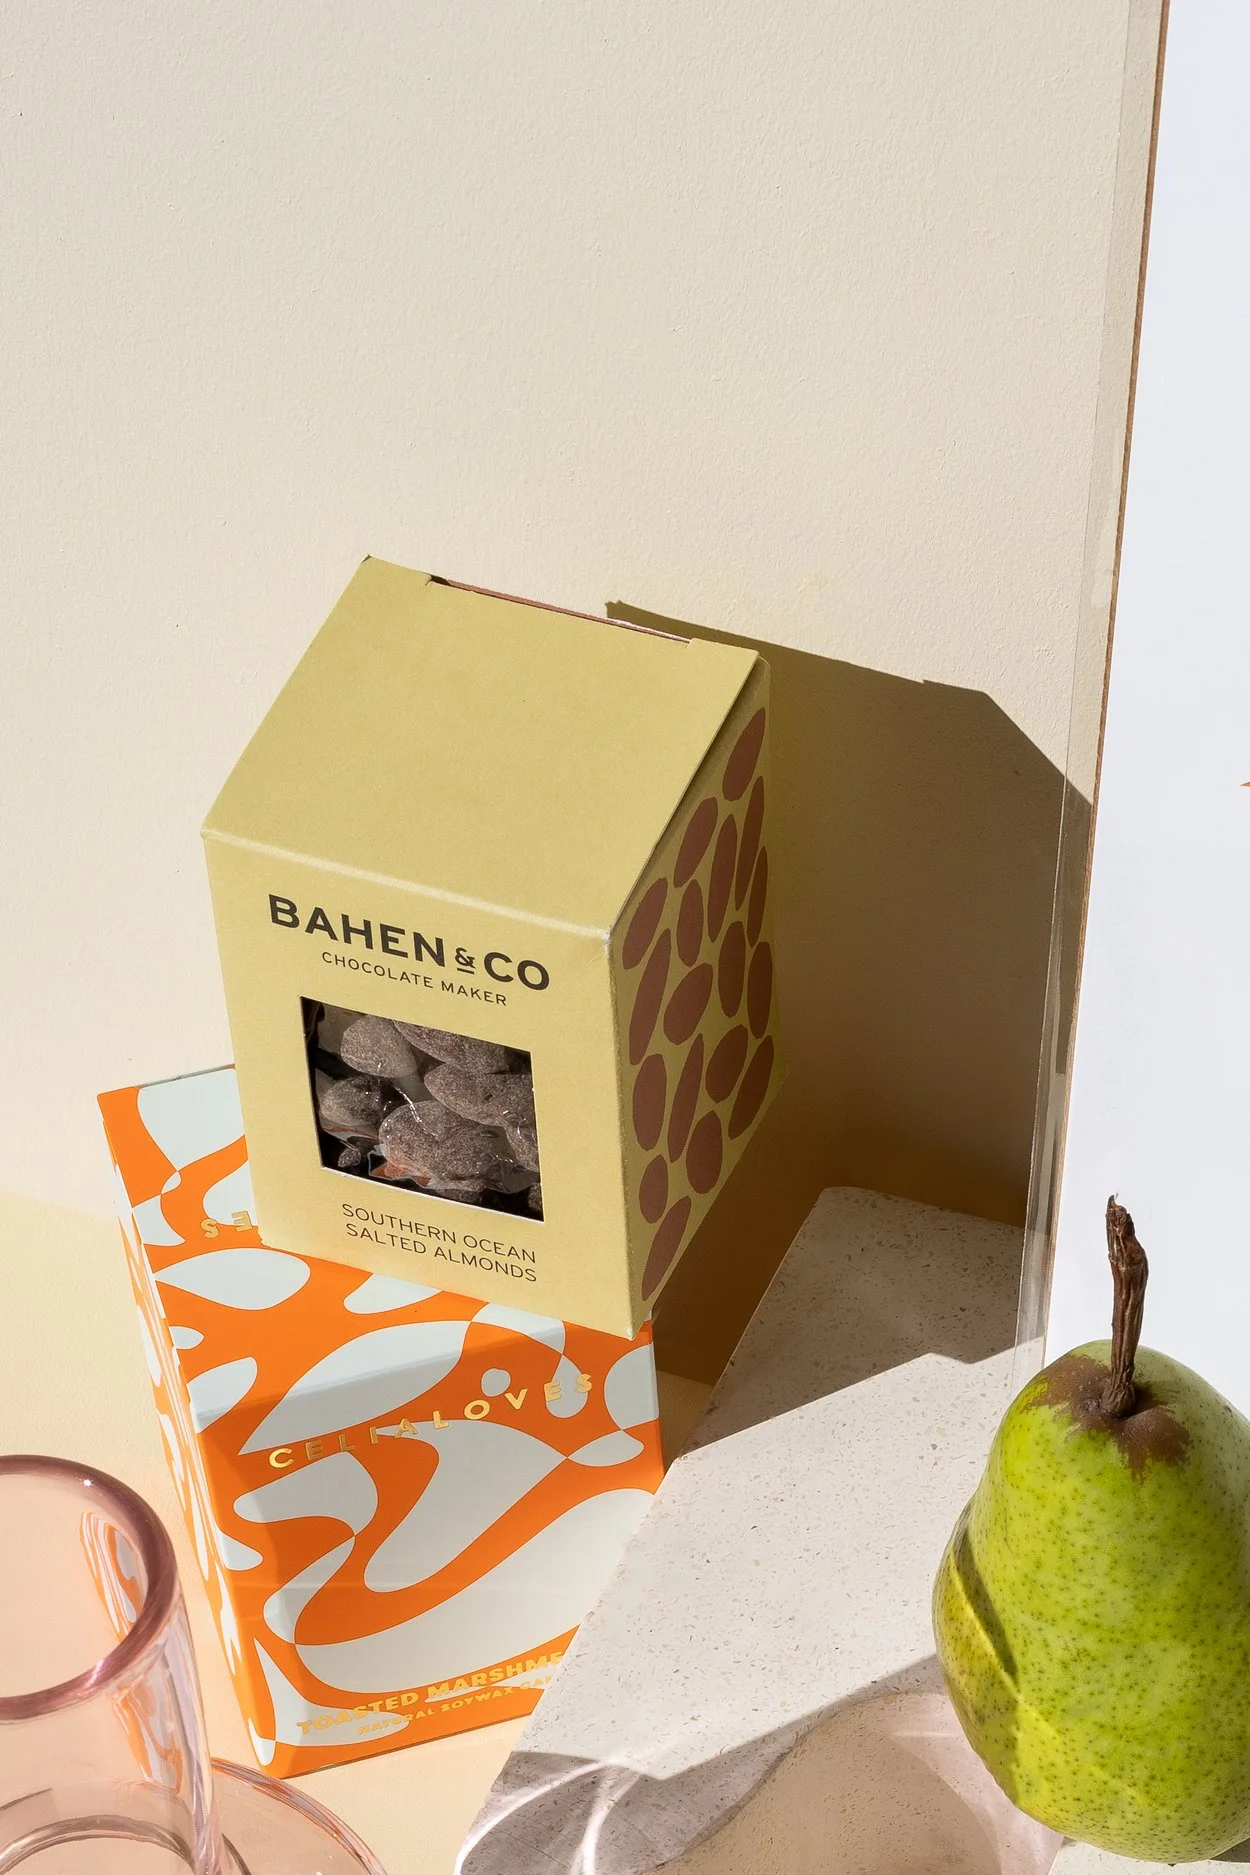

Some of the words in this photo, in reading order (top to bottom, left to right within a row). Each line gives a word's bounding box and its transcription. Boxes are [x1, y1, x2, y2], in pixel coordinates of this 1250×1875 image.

[321, 951, 434, 988] CHOCOLATE
[441, 980, 507, 1006] MAKER
[342, 1203, 456, 1244] SOUTHERN
[463, 1235, 536, 1263] OCEAN
[345, 1223, 426, 1254] SALTED
[434, 1246, 537, 1282] ALMONDS
[296, 1692, 419, 1735] TOASTED
[357, 1708, 435, 1735] NATURAL
[441, 1686, 513, 1712] SOYWAX
